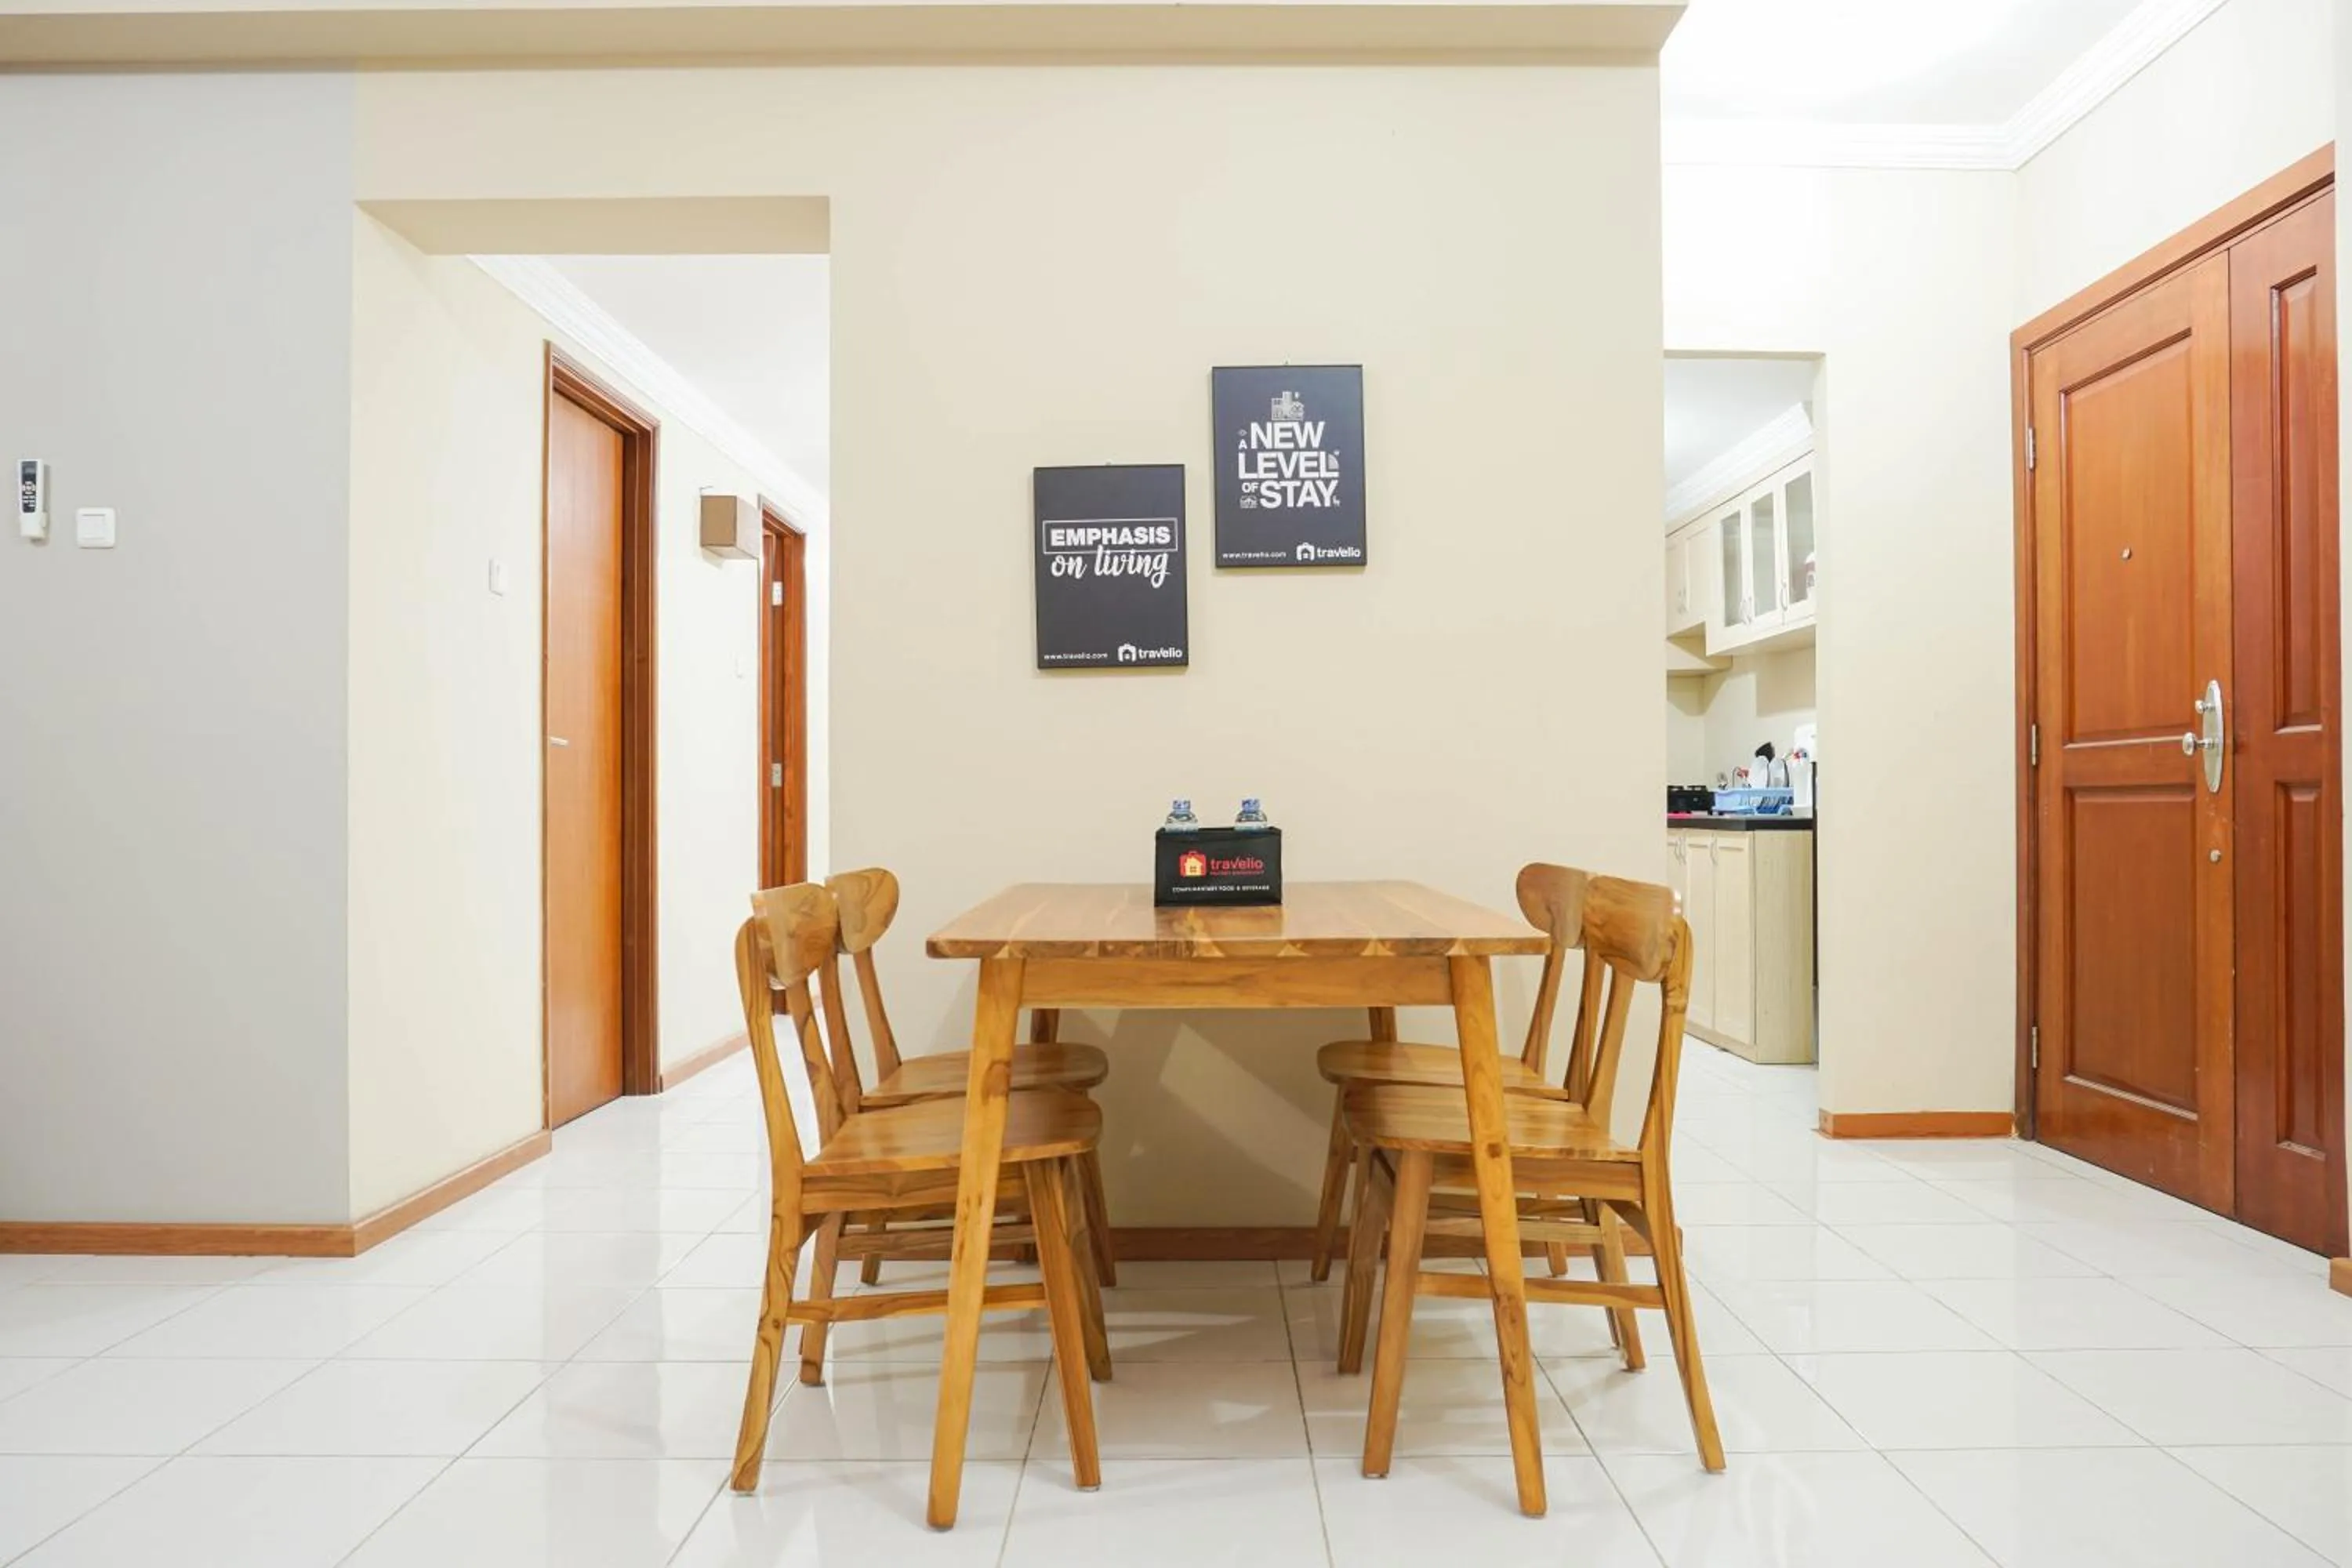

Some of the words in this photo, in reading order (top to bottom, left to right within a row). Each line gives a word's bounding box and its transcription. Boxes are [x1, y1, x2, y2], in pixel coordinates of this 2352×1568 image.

[1238, 439, 1247, 449] A
[1250, 421, 1326, 449] NEW
[1238, 451, 1339, 479] LEVEL
[1241, 482, 1258, 493] OF
[1260, 480, 1338, 509] STAY
[1051, 526, 1171, 546] EMPHASIS
[1317, 546, 1361, 558] travelio
[1051, 554, 1087, 579] on
[1094, 544, 1171, 588] living
[1138, 647, 1183, 659] travelio
[1210, 855, 1264, 870] travelio
